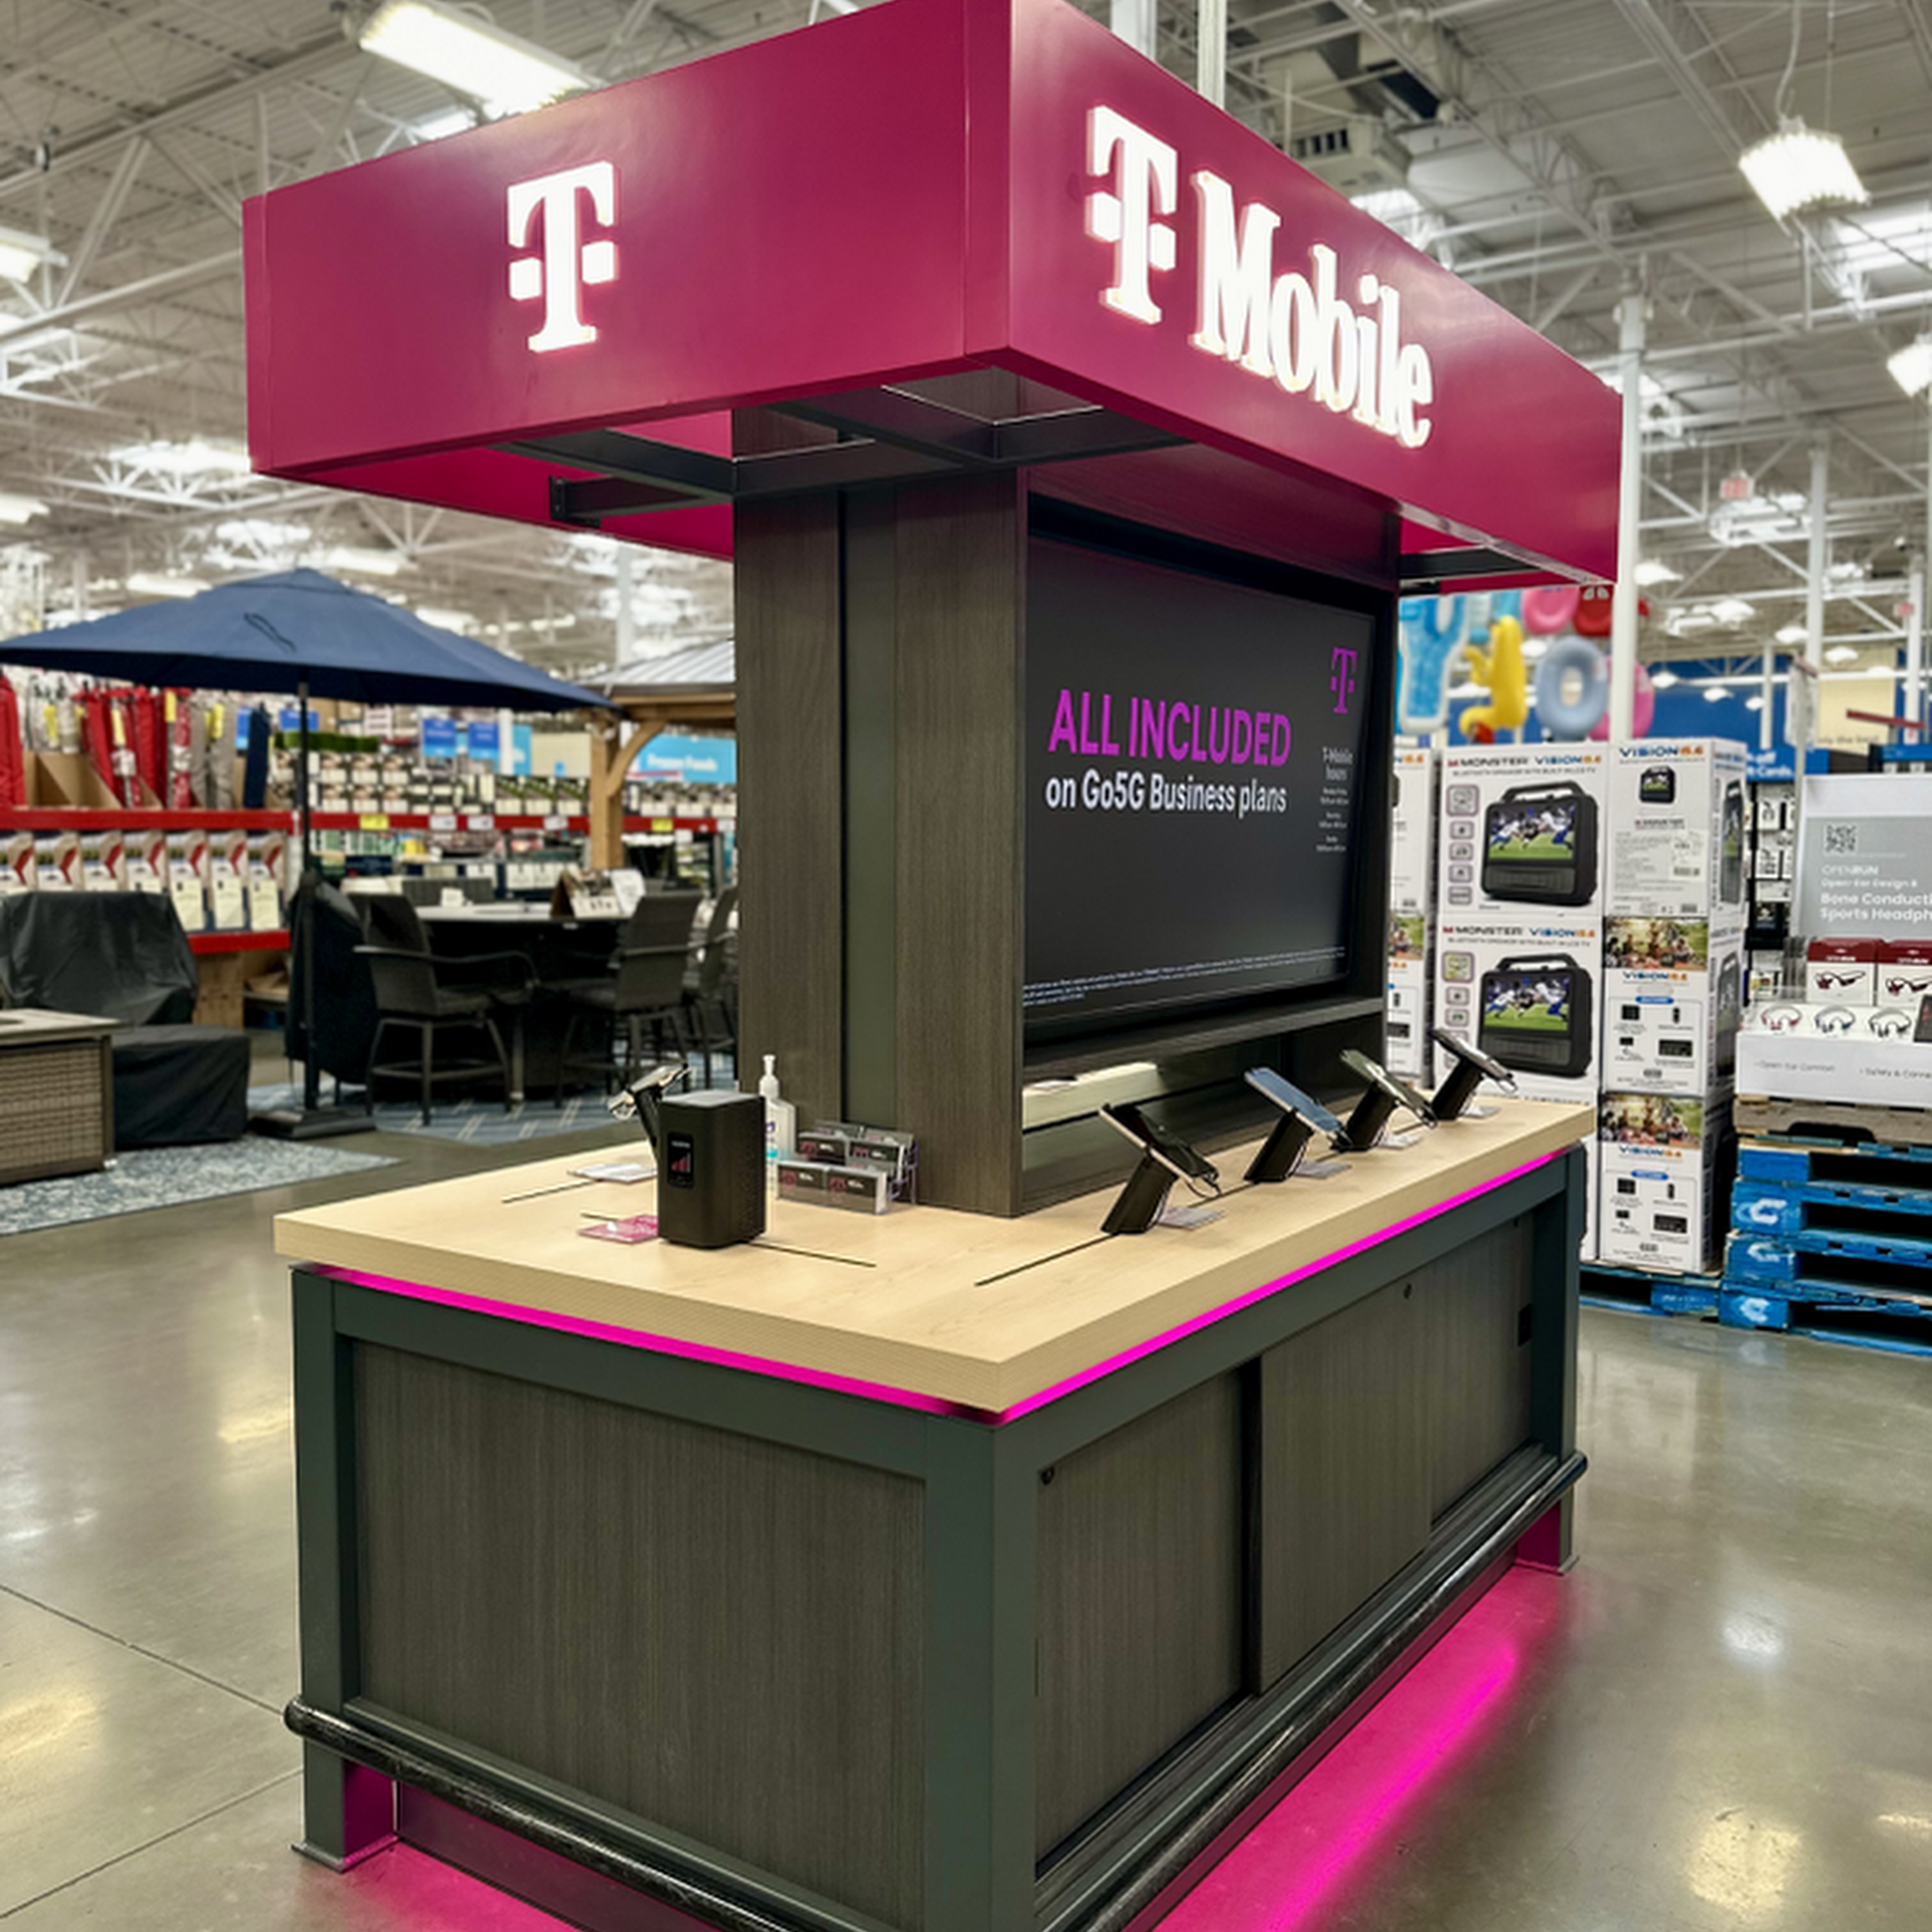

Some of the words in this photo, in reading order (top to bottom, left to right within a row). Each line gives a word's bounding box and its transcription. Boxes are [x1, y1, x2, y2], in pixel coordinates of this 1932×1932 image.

[506, 161, 616, 353] T
[1189, 170, 1434, 448] Mobile
[1048, 689, 1121, 756] ALL
[1128, 696, 1292, 767] INCLUDED
[1461, 756, 1528, 767] MONSTER
[1045, 777, 1077, 810] on
[1081, 768, 1146, 810] Go5G
[1150, 773, 1236, 812] Business
[1238, 779, 1287, 819] plans
[1873, 878, 1910, 891] Design
[1820, 893, 1860, 905] Bone
[1819, 907, 1869, 923] Sports
[1456, 925, 1523, 935] MONSTER
